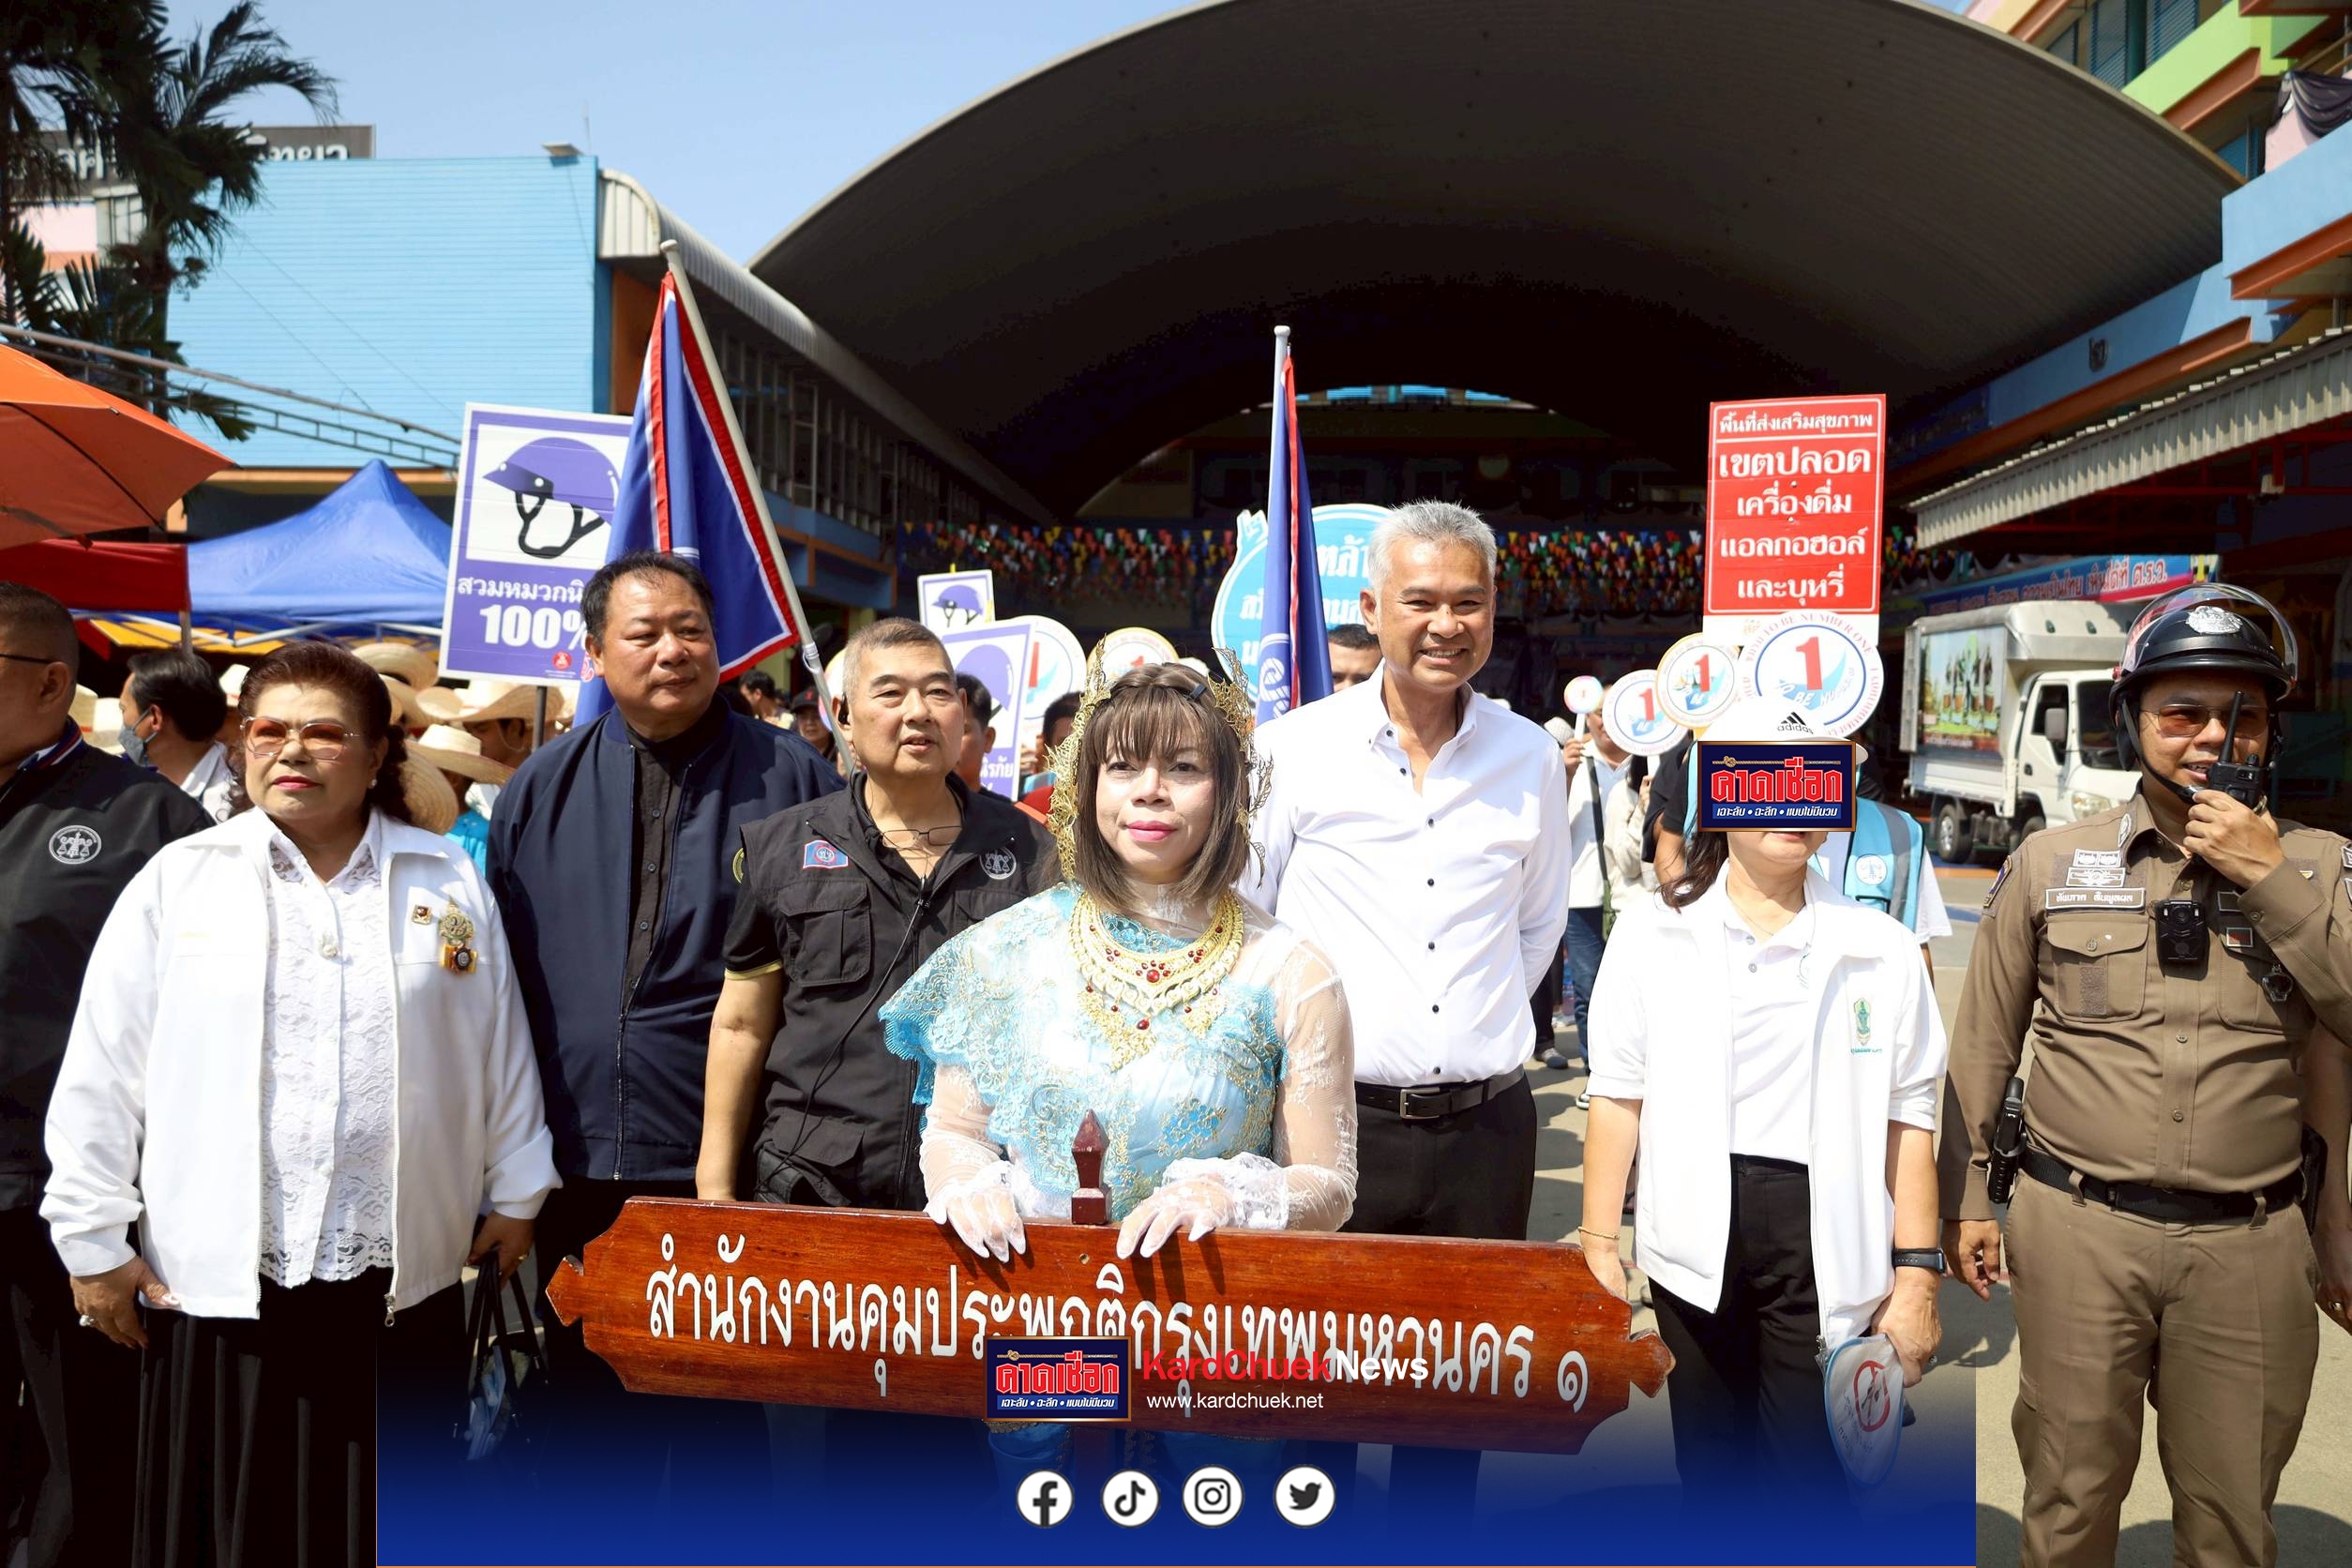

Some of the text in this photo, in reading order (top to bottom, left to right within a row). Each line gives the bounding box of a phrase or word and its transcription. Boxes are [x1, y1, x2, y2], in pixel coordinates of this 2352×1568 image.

[1719, 411, 1873, 434] พื้นที่ส่งเสริมสุขภาพ
[1719, 445, 1871, 478] เขตปลอด
[1736, 478, 1852, 517] เครื่องดื่ม
[1720, 526, 1868, 558] แอลกอฮอล์
[1737, 563, 1844, 606] และบุหรี่
[479, 604, 587, 651] 100%
[1694, 654, 1711, 692] 1
[1795, 636, 1823, 691] 1
[1638, 687, 1655, 721] 1
[1776, 723, 1815, 735] adidas
[1556, 1350, 1591, 1414] ๑
